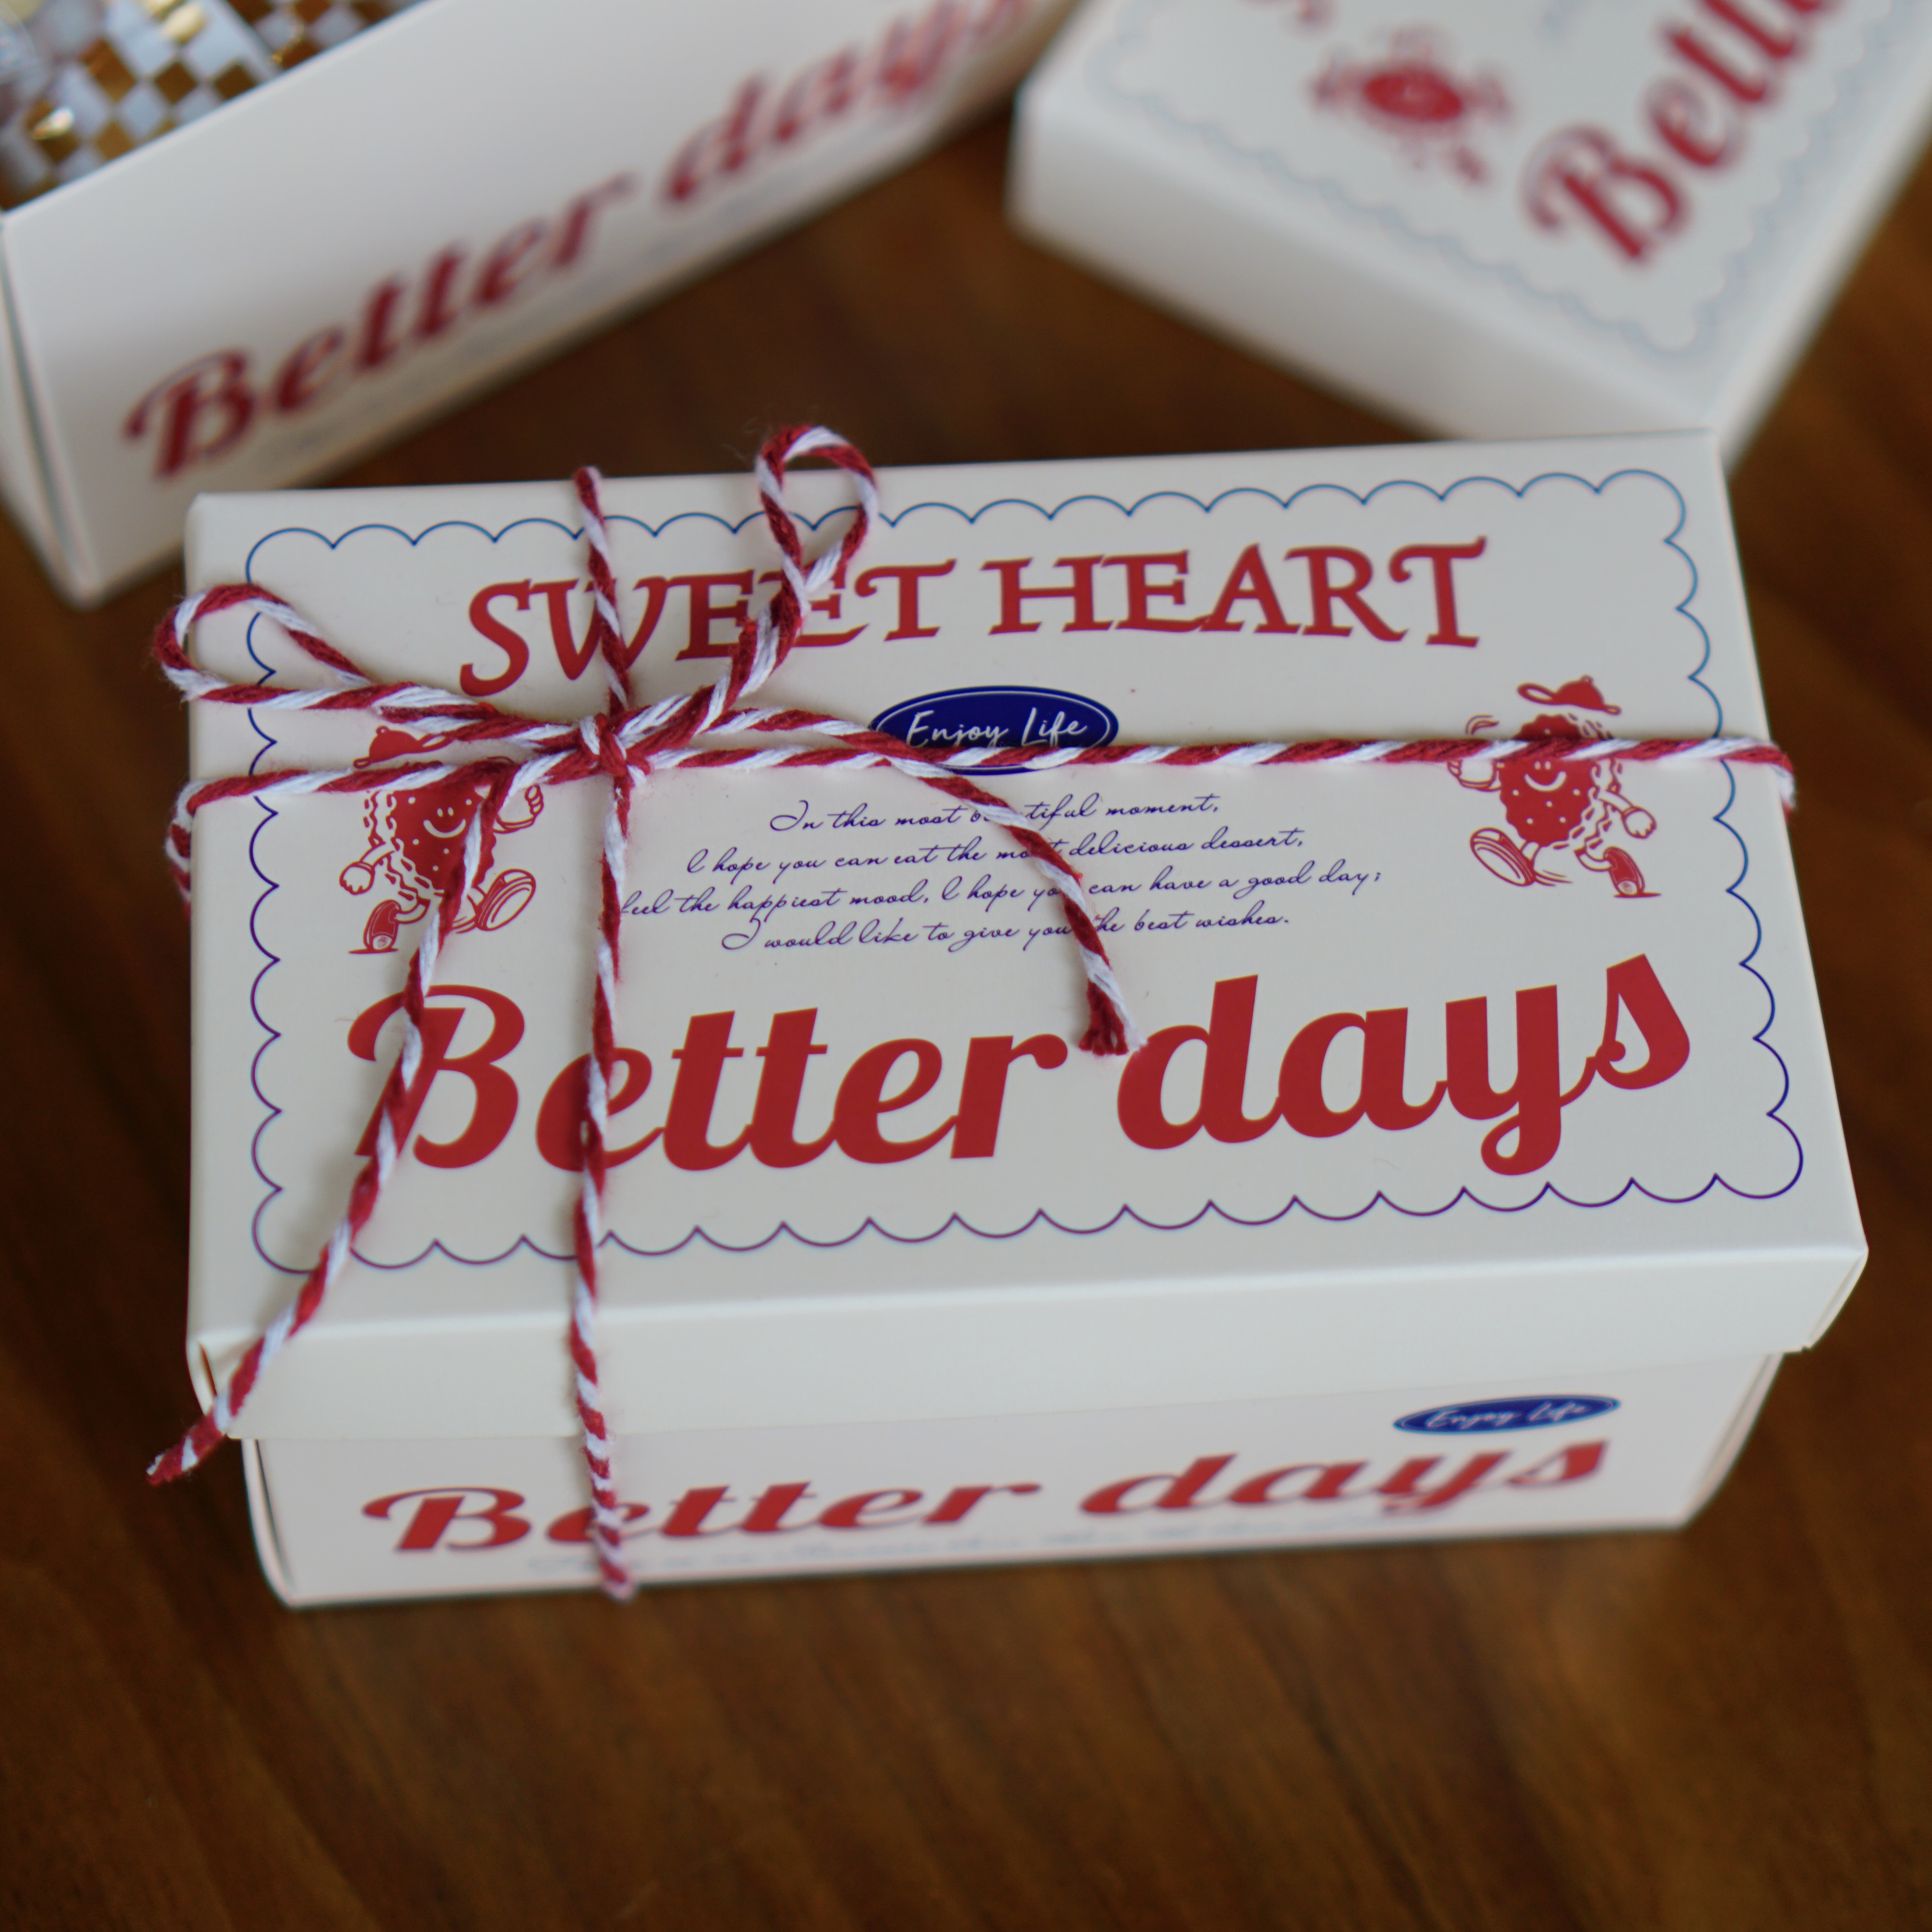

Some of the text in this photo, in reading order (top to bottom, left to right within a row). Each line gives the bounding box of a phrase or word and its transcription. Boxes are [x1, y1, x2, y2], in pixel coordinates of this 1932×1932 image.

[1517, 0, 1828, 266] Bett
[120, 171, 640, 483] Better
[460, 536, 1487, 696] SWEET HEART
[905, 707, 1087, 748] Enjoy Life
[769, 792, 1220, 831] In this most btiful moment,
[712, 847, 771, 885] hope
[772, 859, 827, 884] you
[835, 856, 889, 867] can
[894, 845, 938, 864] eat
[939, 836, 987, 862] the
[996, 838, 1070, 861] mot
[1068, 830, 1194, 857] delicious
[1201, 825, 1305, 850] dessert,
[674, 886, 720, 913] the
[727, 885, 849, 923] happiest
[849, 879, 929, 905] mood,
[966, 873, 1025, 912] hope
[1027, 887, 1060, 912] yo
[1089, 884, 1142, 895] can
[1149, 865, 1212, 891] have
[1218, 879, 1239, 888] a
[1233, 860, 1312, 899] good
[1319, 858, 1381, 896] day;
[721, 899, 1291, 953] I would like to give you he best wishes.
[347, 952, 1690, 1176] Better days
[1426, 1402, 1592, 1430] Enjoy Life
[361, 1482, 1041, 1553] Better
[1078, 1440, 1608, 1516] days
